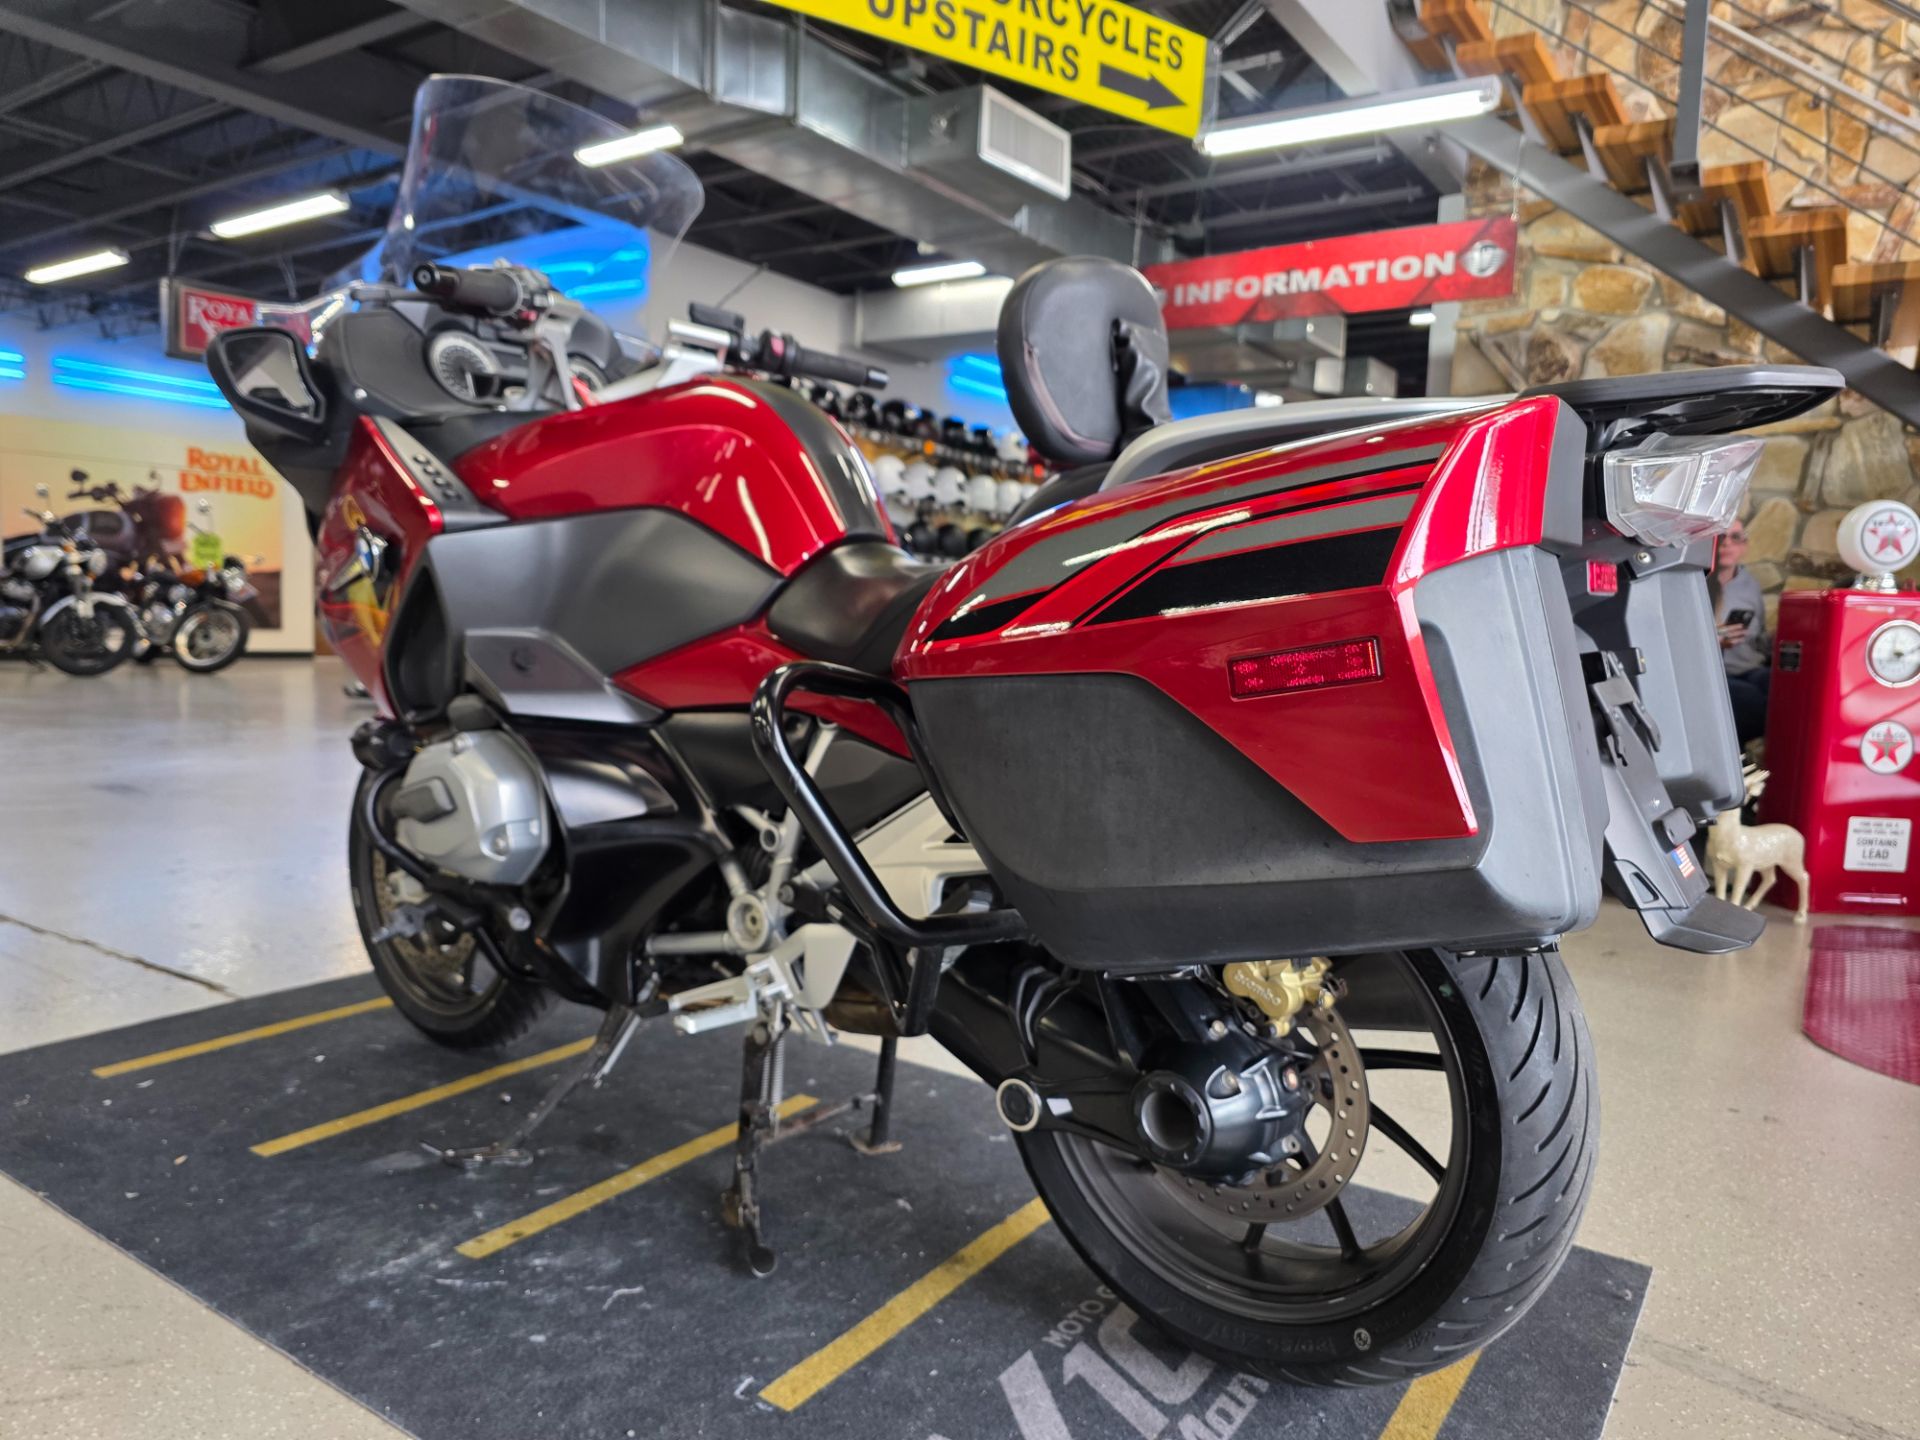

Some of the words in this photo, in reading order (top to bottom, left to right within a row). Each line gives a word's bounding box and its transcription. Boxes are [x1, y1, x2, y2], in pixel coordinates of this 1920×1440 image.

[992, 0, 1184, 71] RCYCLES
[1173, 250, 1456, 307] INFORMATION
[188, 294, 251, 336] ROYA
[186, 446, 264, 477] ROYAL
[179, 471, 275, 500] ENFIELD
[1856, 837, 1898, 848] CONTAINS
[1862, 848, 1890, 860] LEAD
[1041, 1299, 1105, 1349] MOTO
